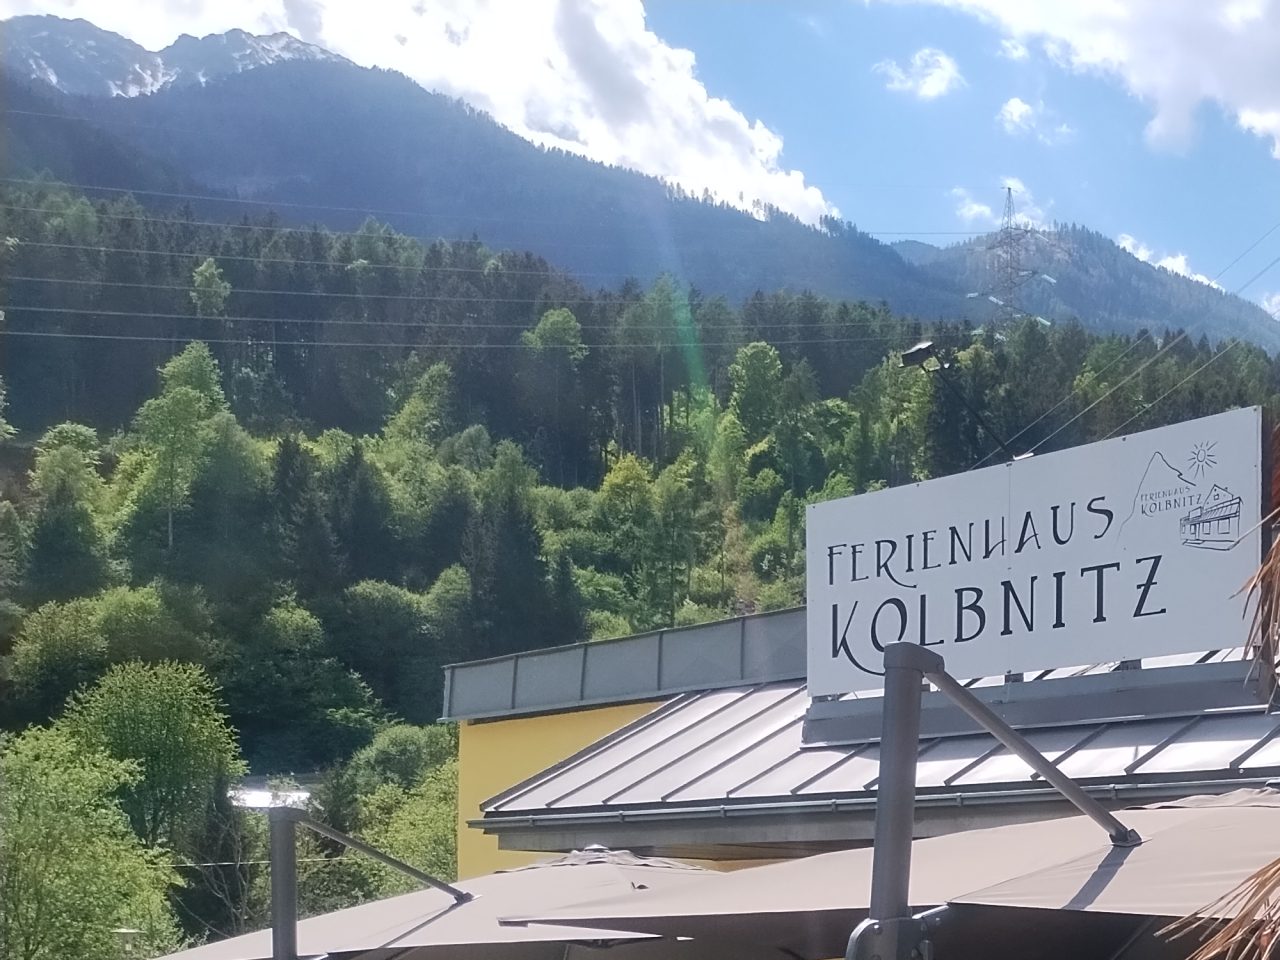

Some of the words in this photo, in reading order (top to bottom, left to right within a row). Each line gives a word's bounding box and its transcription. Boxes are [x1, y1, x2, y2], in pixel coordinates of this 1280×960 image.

[1140, 486, 1191, 502] FERIENHAUS
[1141, 494, 1202, 517] KOLBNITZ
[827, 496, 1115, 589] FERIENHAUS
[831, 555, 1167, 676] KOLBNITZ
